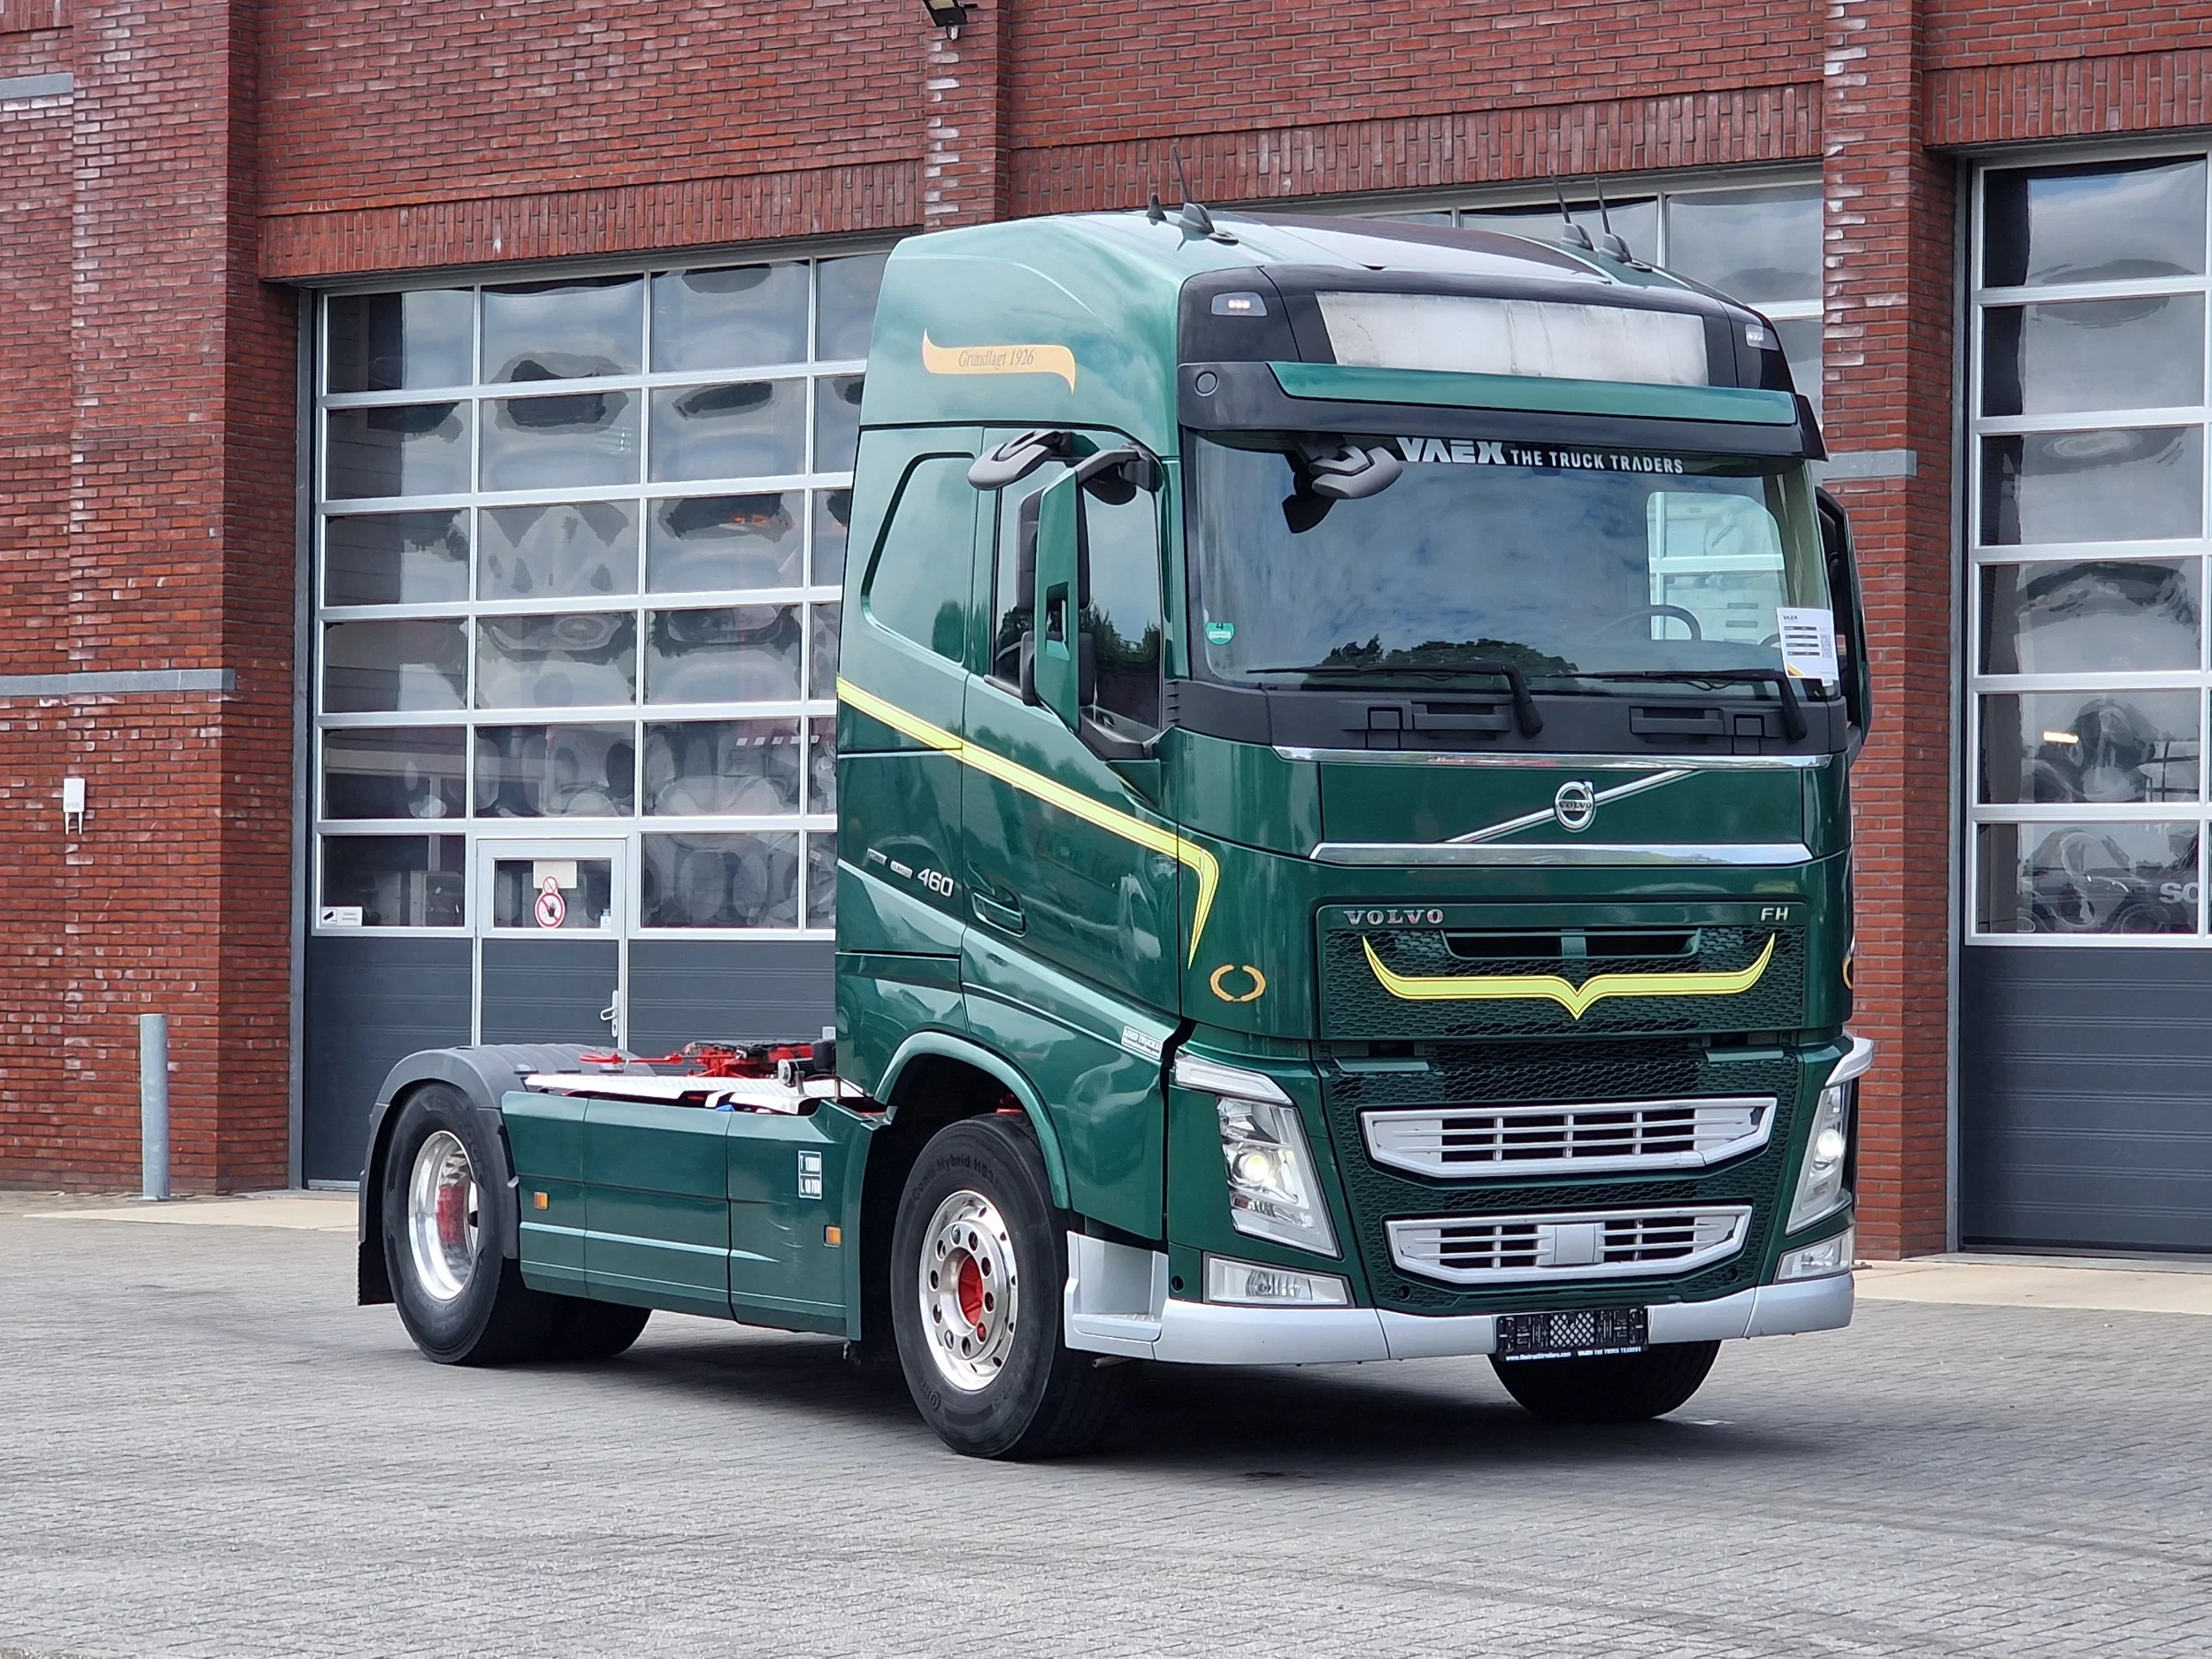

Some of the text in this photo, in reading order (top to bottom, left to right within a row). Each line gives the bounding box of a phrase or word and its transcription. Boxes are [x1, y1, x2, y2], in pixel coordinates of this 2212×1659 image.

[1009, 348, 1035, 366] 1926
[1395, 436, 1684, 474] VAEX THE TRUCK TRADERS
[917, 868, 954, 898] 460
[1342, 909, 1444, 926] VOLVO
[1760, 907, 1789, 922] FH
[936, 1153, 972, 1172] Hybrid
